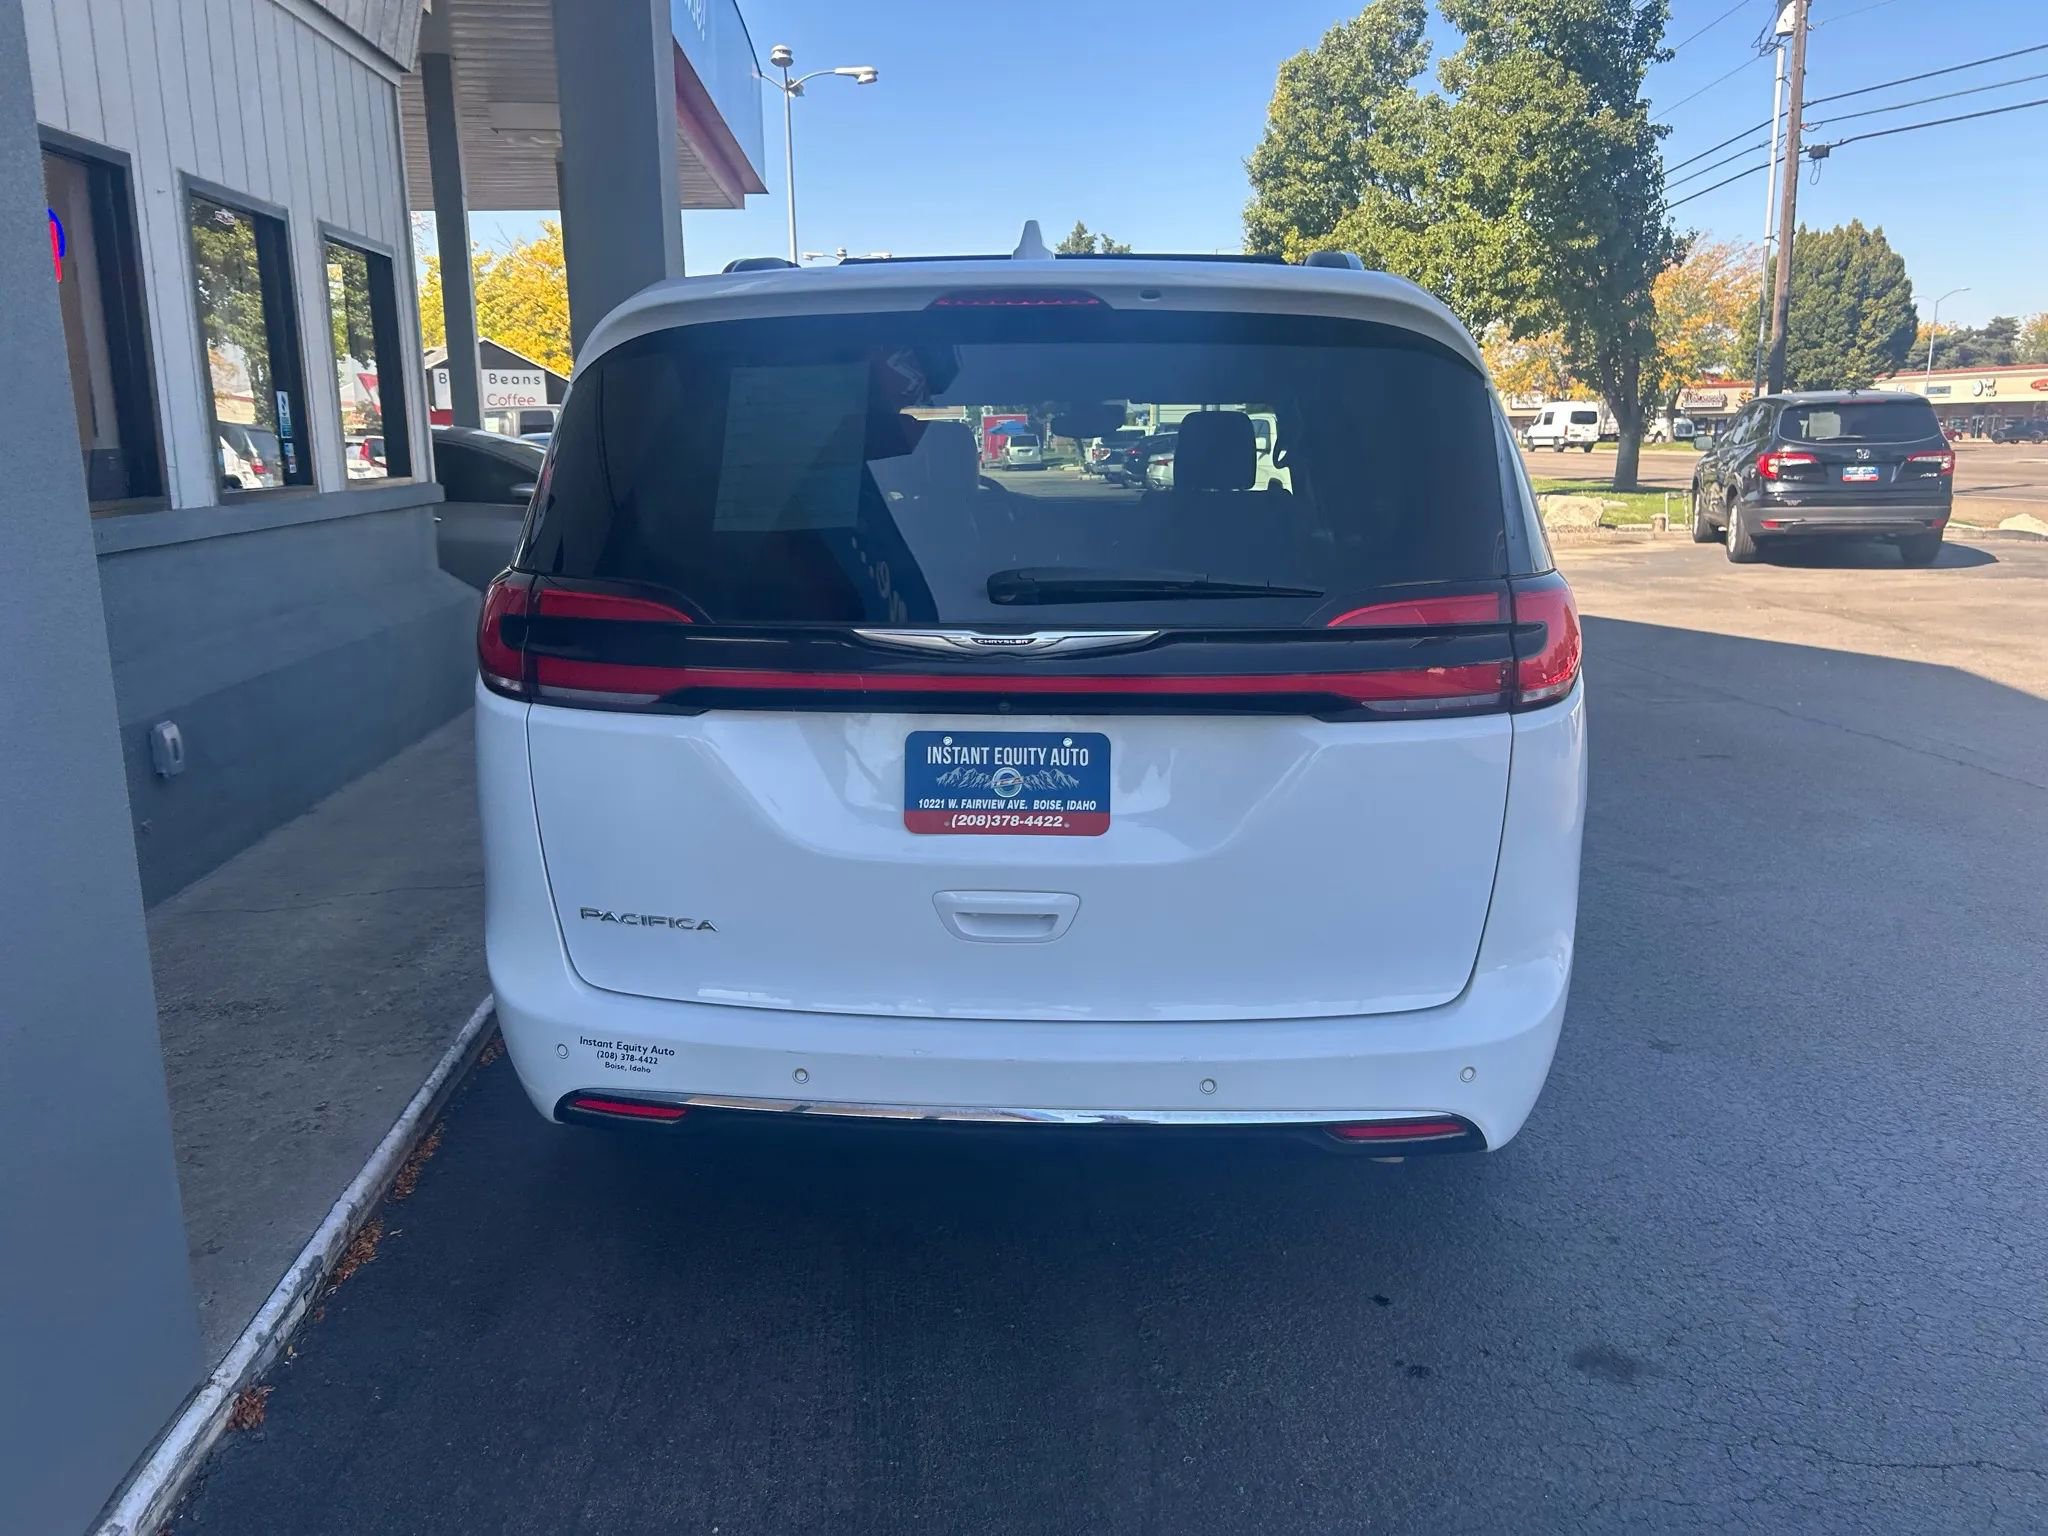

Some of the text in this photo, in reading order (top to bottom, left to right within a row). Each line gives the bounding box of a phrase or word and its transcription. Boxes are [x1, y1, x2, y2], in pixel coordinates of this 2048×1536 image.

[489, 373, 541, 385] Beans
[487, 393, 536, 406] Coffee
[927, 746, 1089, 766] INSTANT EQUITY AUTO
[918, 799, 1096, 812] 10221 W. FAIRVIEW AVE. BOISE, IDAHO
[951, 814, 1063, 828] (208)378-4422
[580, 907, 720, 932] PACIFICA
[580, 1036, 675, 1056] Instant Equity Auto
[596, 1050, 658, 1065] (208) 378-4422
[604, 1062, 651, 1074] Boise, Idaho
